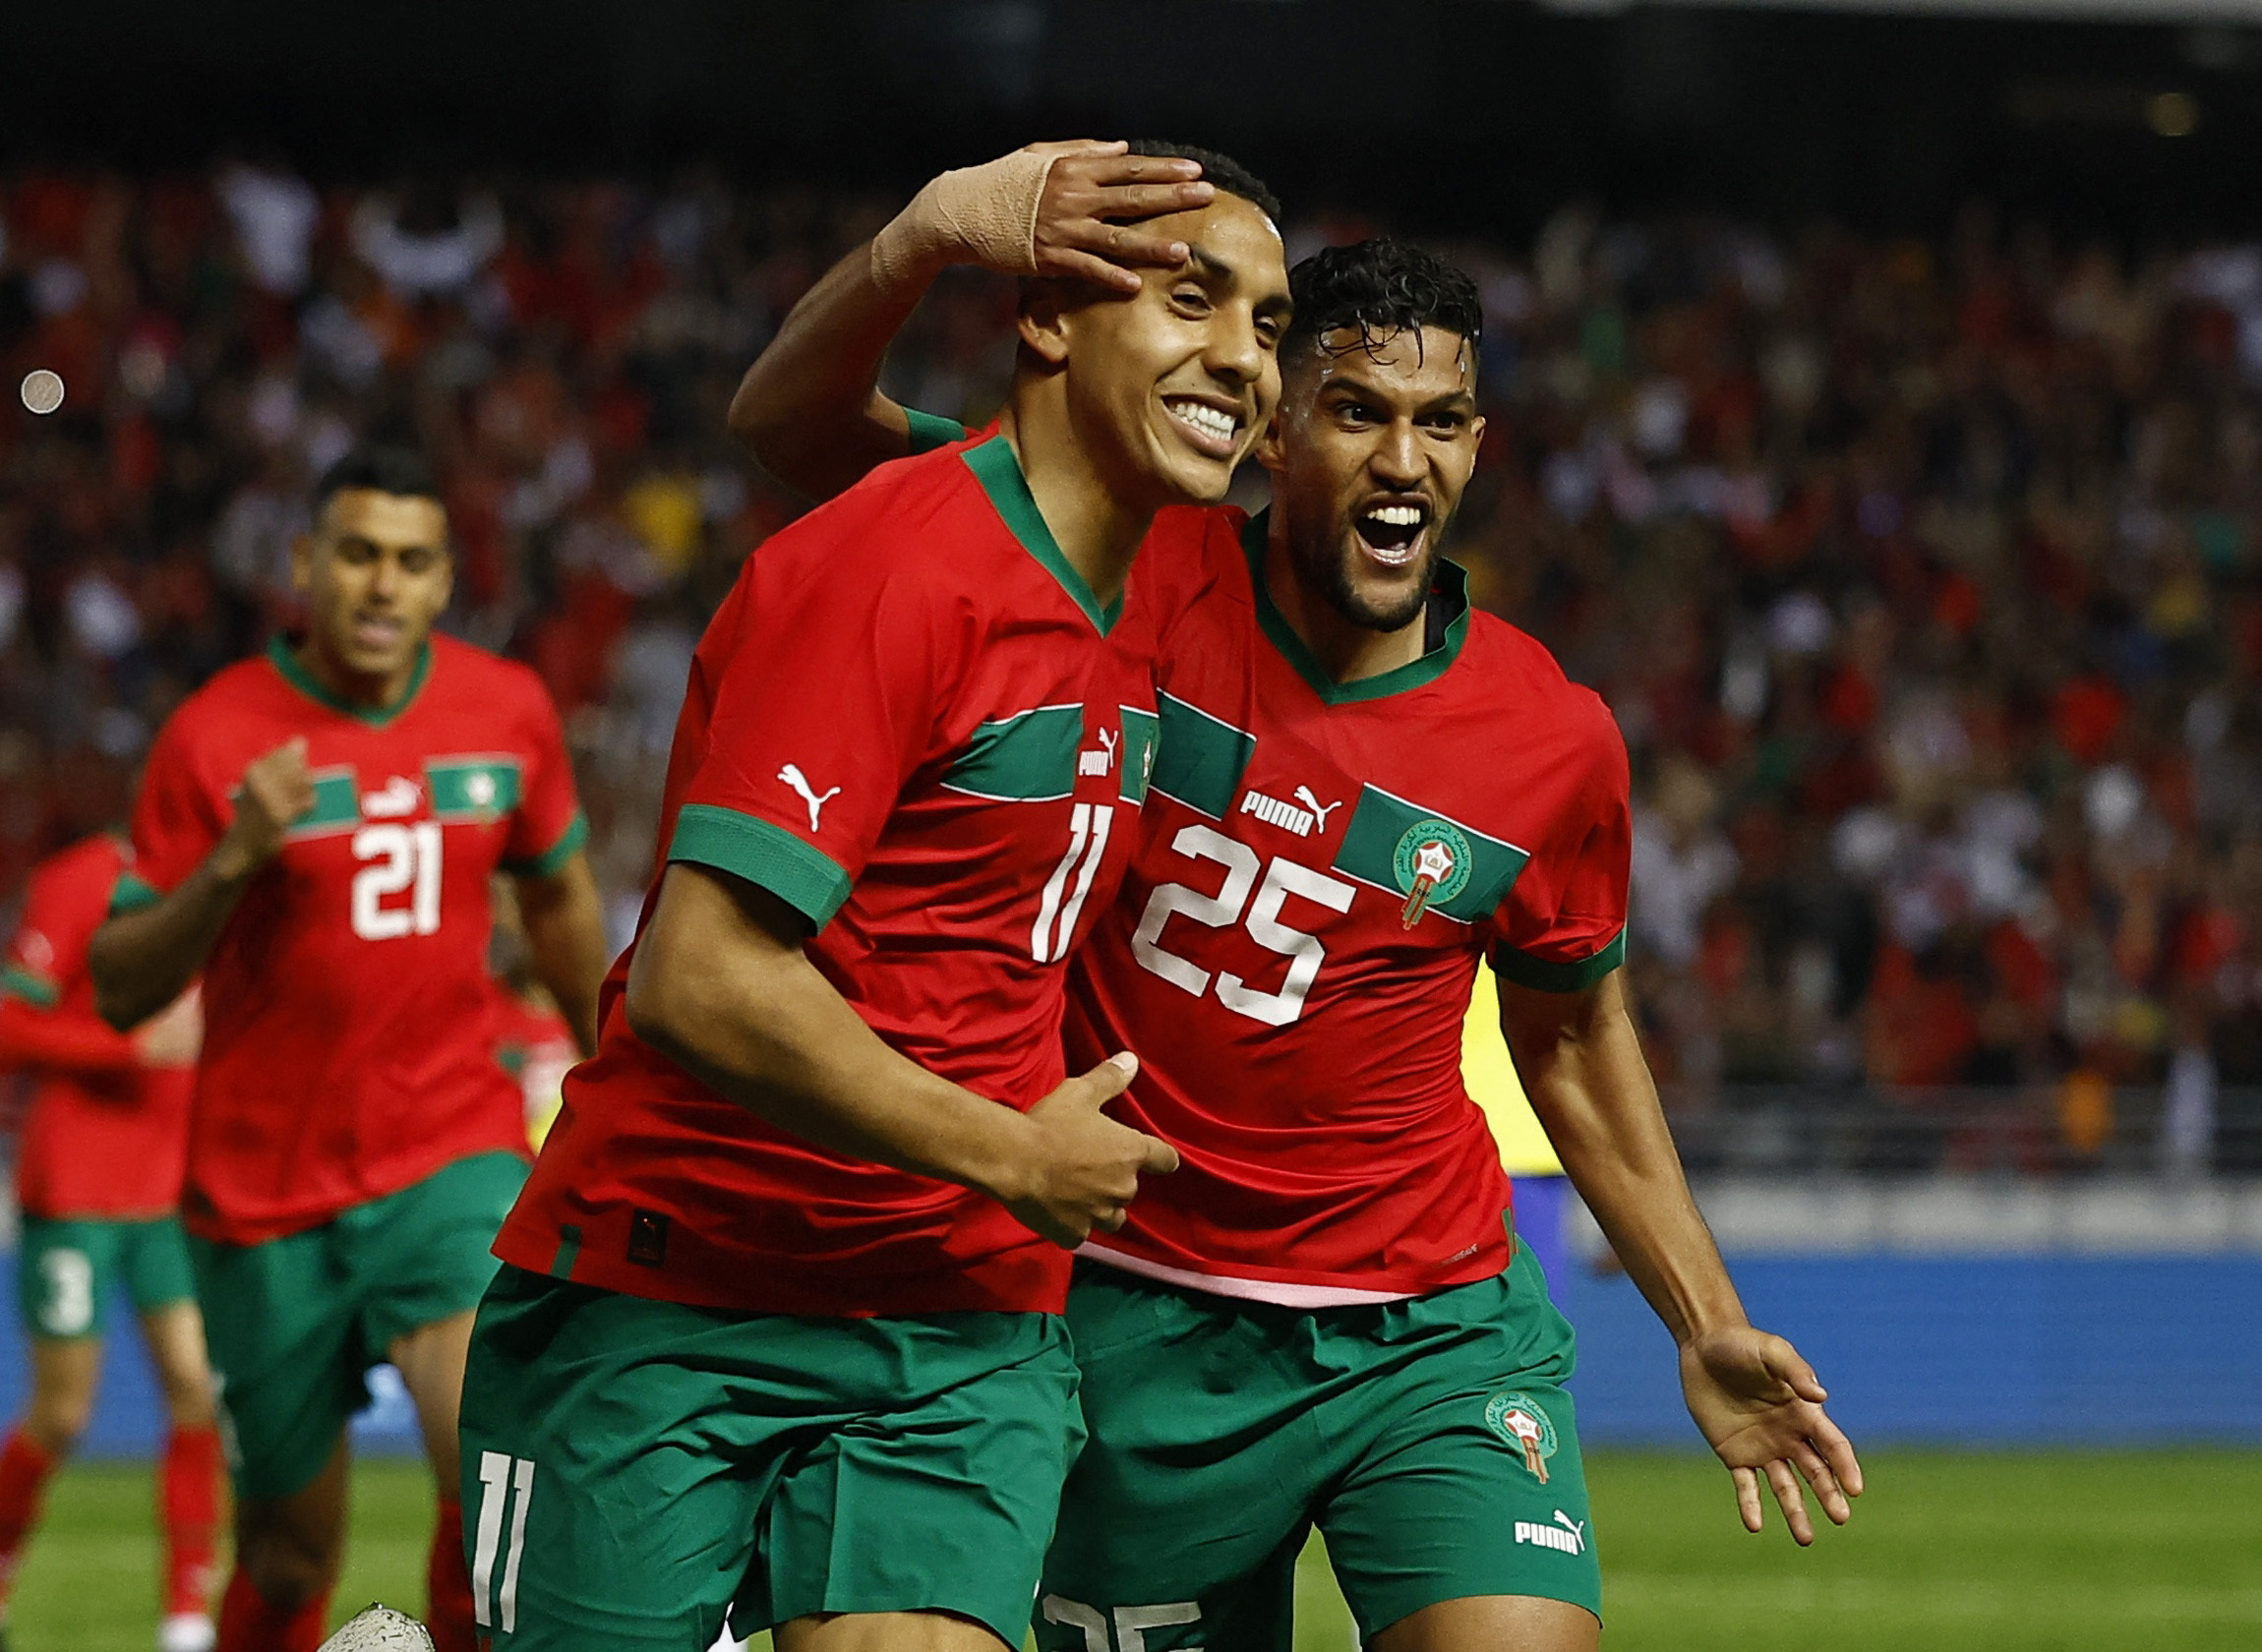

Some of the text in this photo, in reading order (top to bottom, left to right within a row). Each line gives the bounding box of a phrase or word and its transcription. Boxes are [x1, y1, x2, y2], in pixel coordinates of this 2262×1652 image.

[351, 820, 444, 941] 21
[1031, 802, 1114, 964] 11
[1239, 790, 1315, 838] PUMA
[1130, 823, 1357, 1027] 25
[472, 1450, 535, 1634] 11
[1515, 1521, 1578, 1556] PUMA
